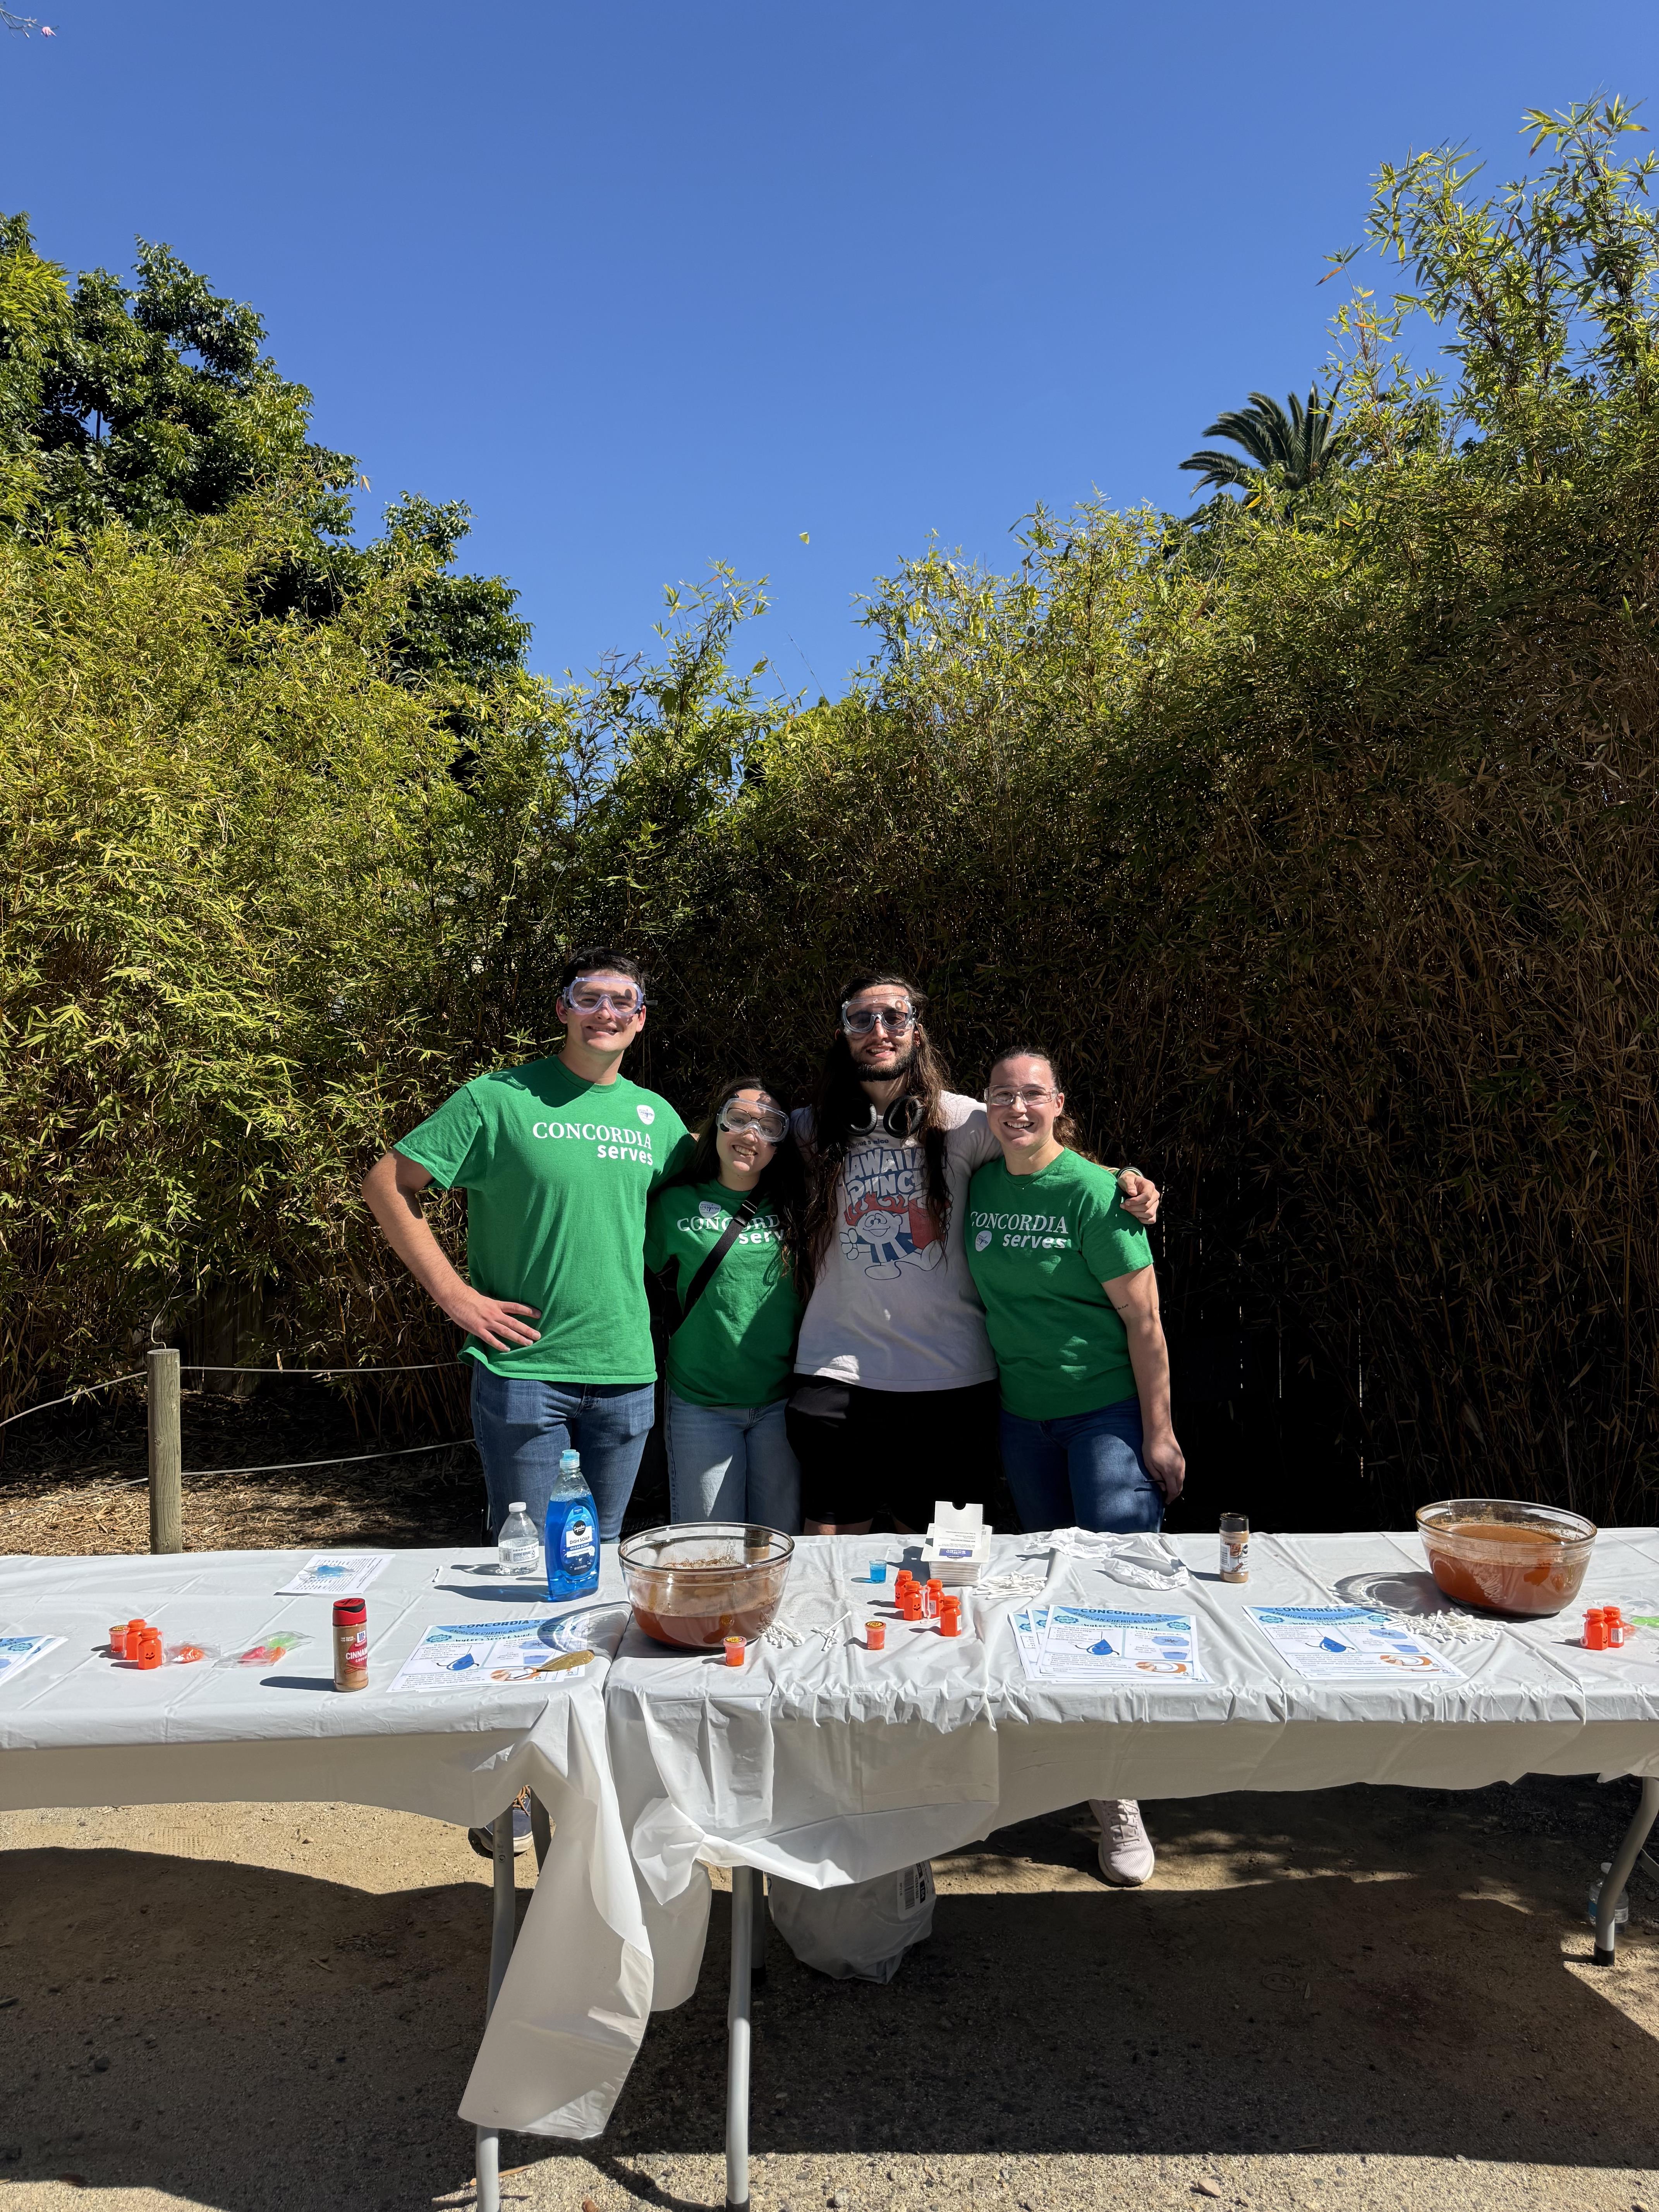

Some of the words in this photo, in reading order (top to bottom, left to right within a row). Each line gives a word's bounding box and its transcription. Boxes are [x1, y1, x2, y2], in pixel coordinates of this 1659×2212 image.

[533, 1122, 652, 1150] CONCORDIA
[597, 1144, 653, 1166] serves
[739, 1230, 784, 1245] serv
[1003, 1233, 1067, 1249] serves
